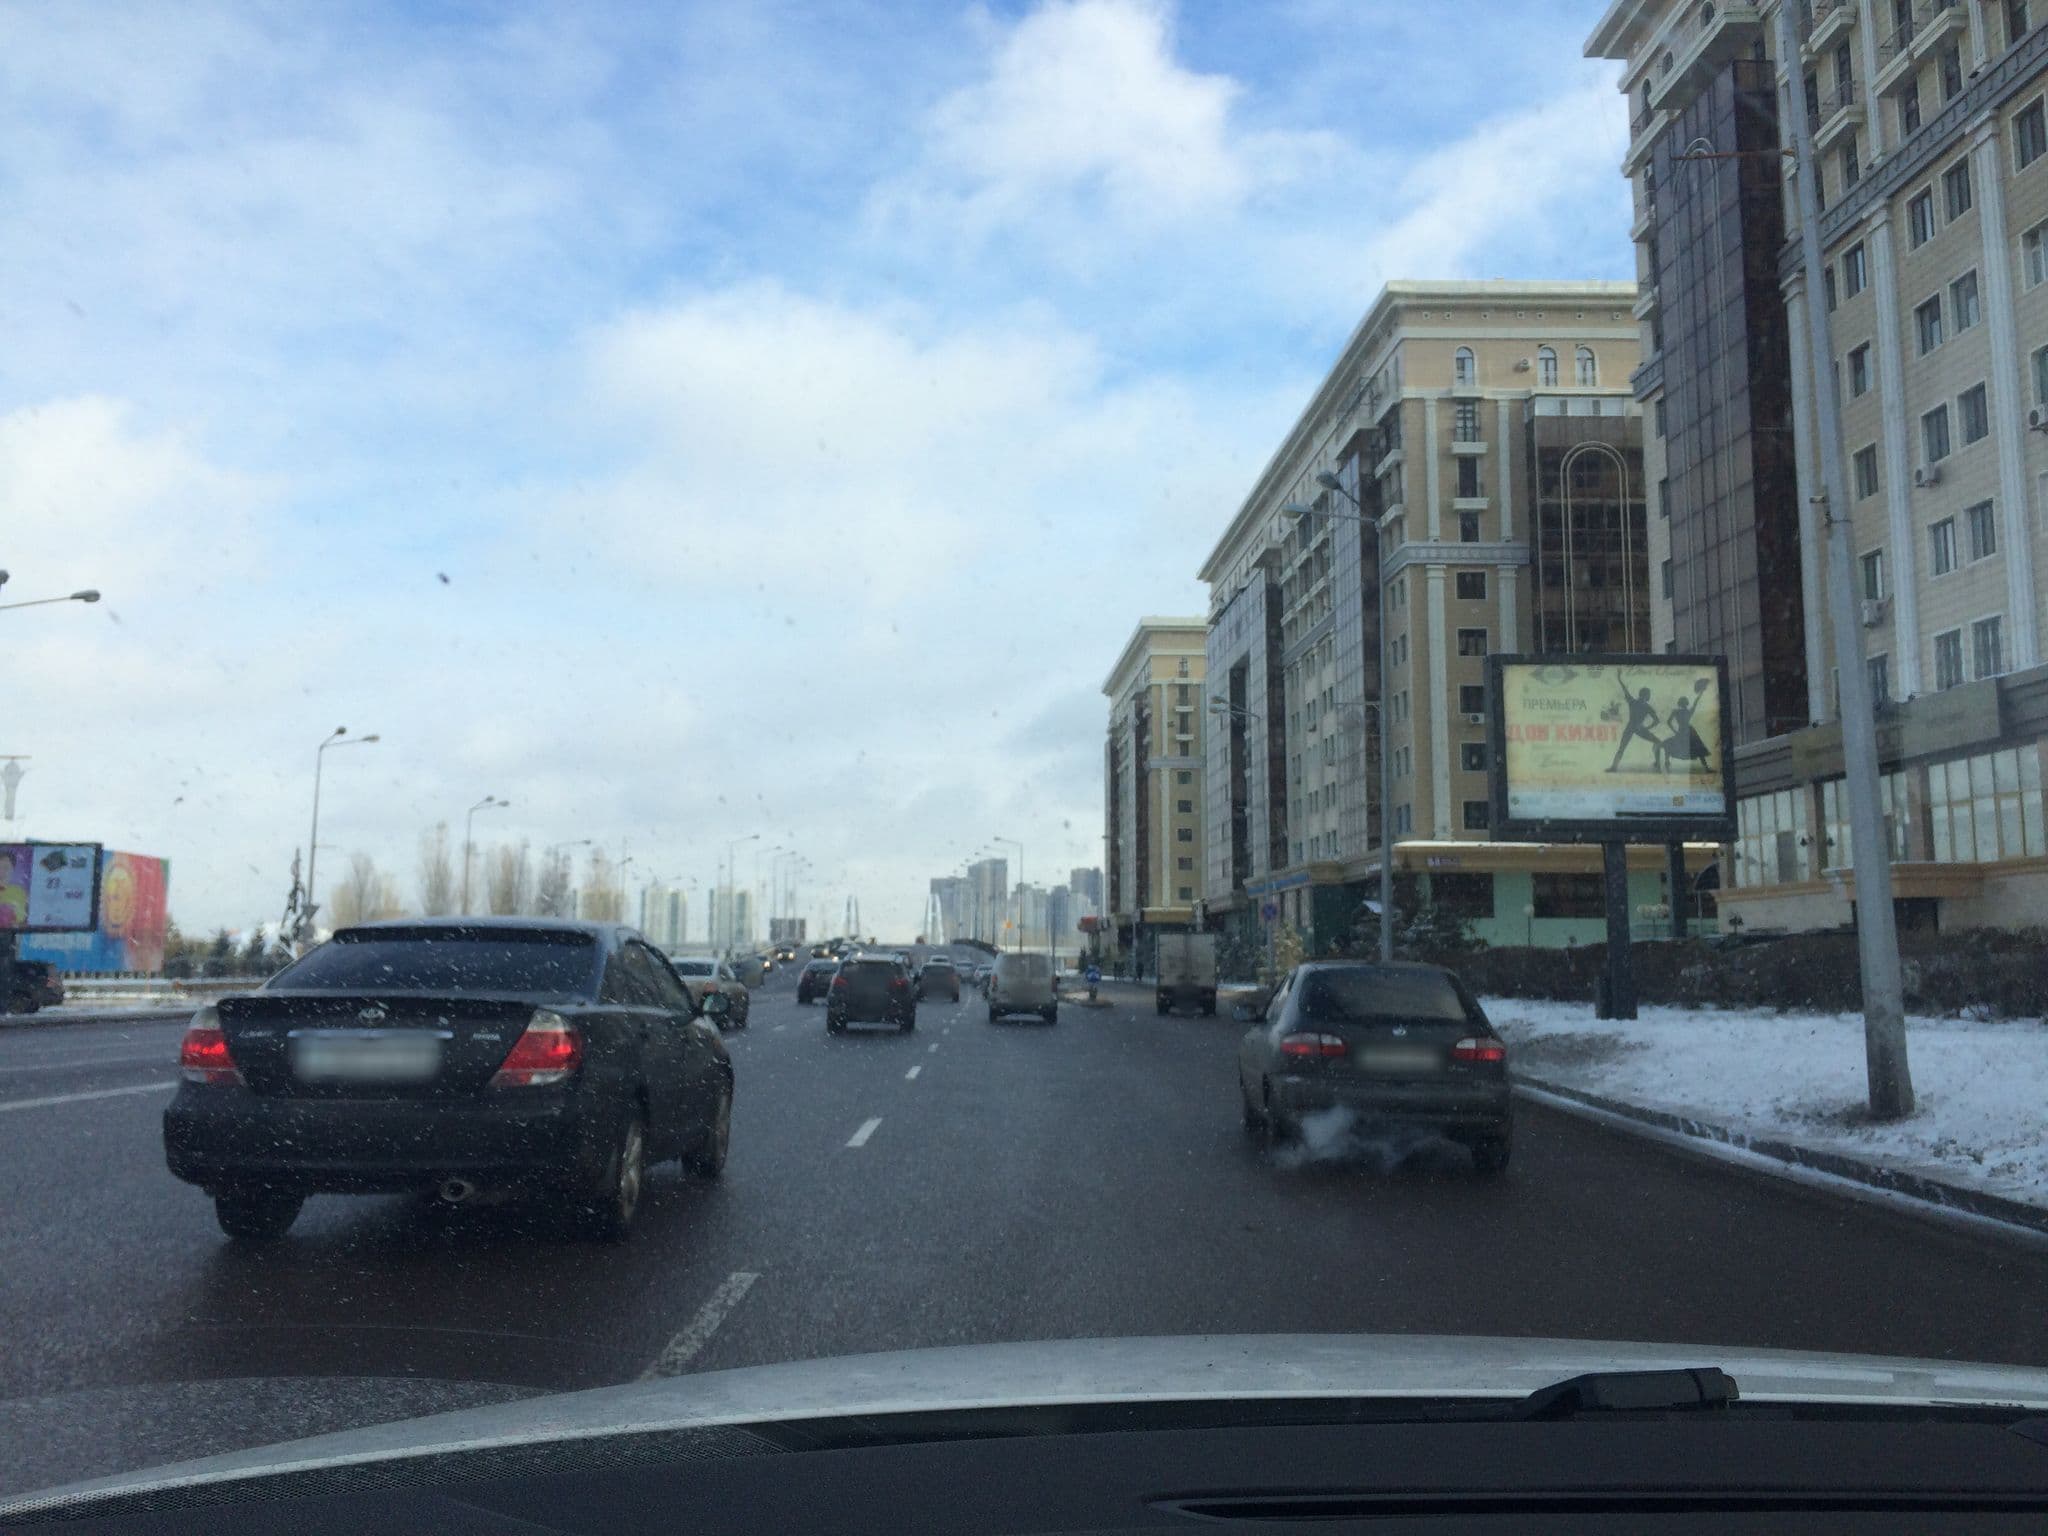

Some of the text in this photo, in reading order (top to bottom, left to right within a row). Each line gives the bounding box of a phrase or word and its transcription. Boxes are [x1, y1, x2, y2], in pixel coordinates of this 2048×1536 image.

[1522, 697, 1588, 711] ПРЕМЬЕРА
[1508, 722, 1618, 744] ДОН КИХОТ
